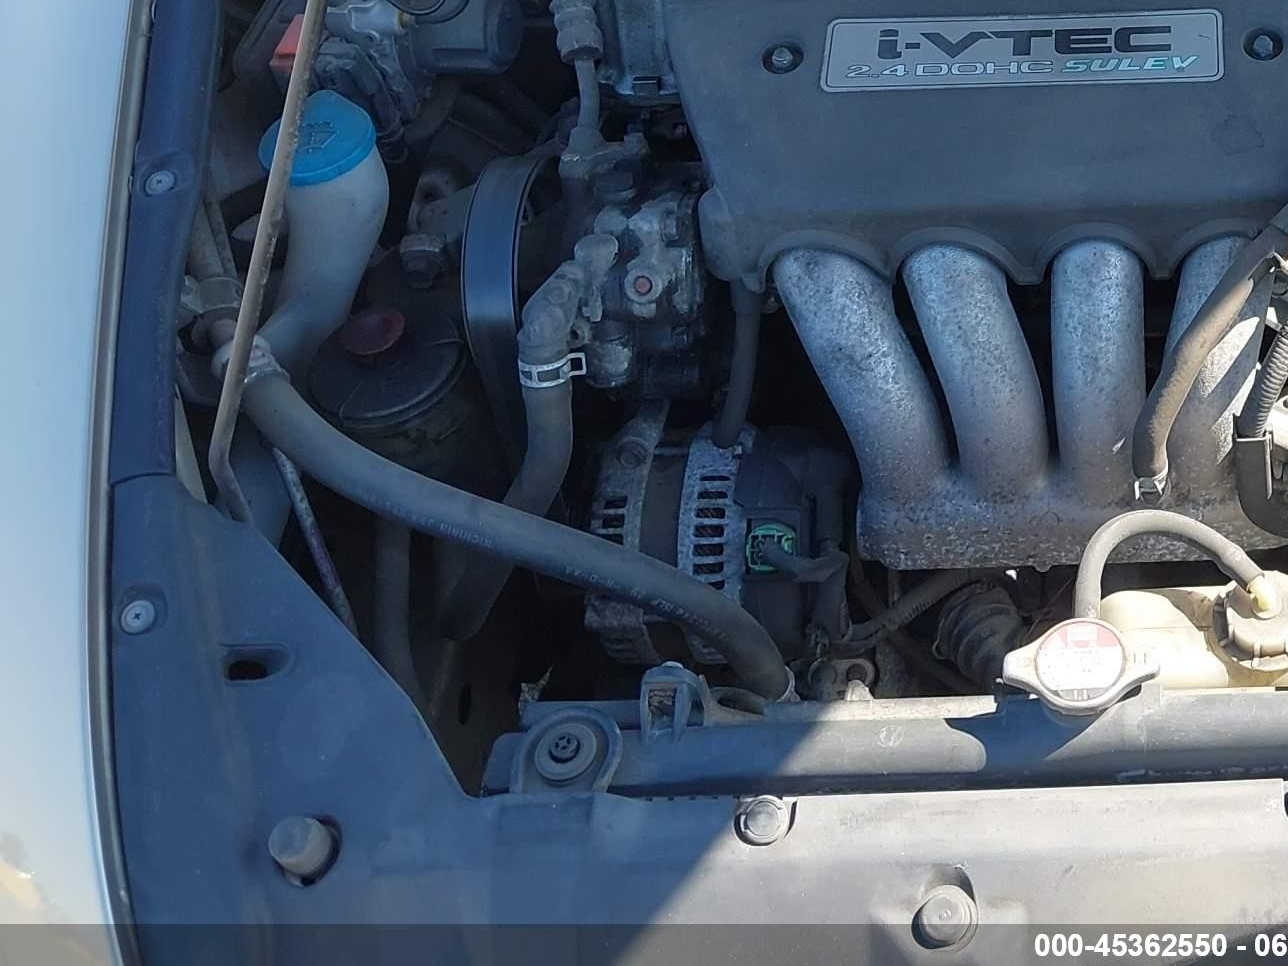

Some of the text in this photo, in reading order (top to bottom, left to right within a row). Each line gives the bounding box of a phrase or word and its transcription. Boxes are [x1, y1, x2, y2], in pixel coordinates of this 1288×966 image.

[877, 25, 1172, 60] i-VTEC
[845, 54, 1199, 79] 2.4 DOHC SULEV
